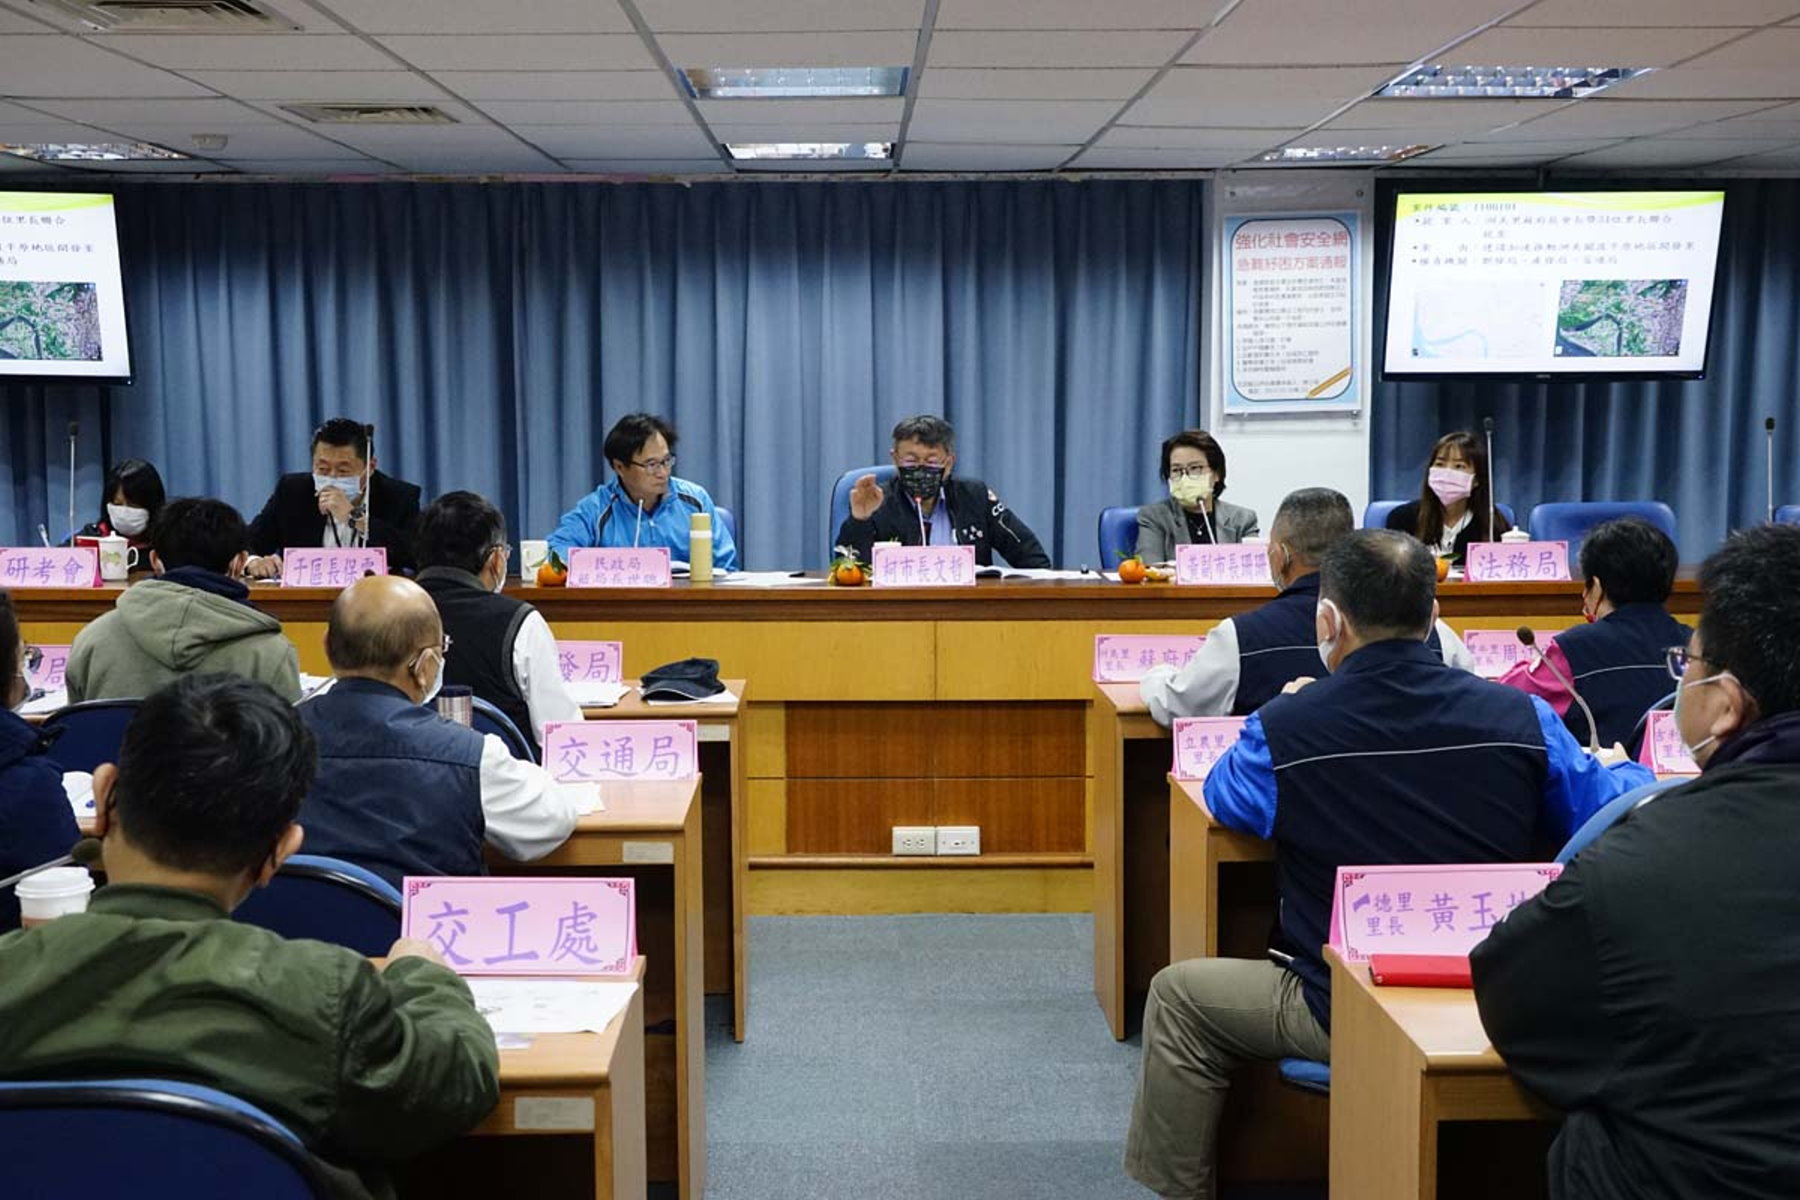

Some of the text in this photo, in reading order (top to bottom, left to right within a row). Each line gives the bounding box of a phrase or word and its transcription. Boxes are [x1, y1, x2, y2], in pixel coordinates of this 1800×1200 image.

[1235, 231, 1348, 249] 強化社會安全網
[5, 555, 84, 585] 研考會
[595, 557, 641, 571] 民政局
[882, 555, 964, 584] 柯市長文哲
[1479, 550, 1558, 579] 法務局
[558, 735, 680, 779] 交通局
[1352, 891, 1414, 913] 一德里
[427, 900, 604, 966] 交工處
[1366, 916, 1406, 937] 里長
